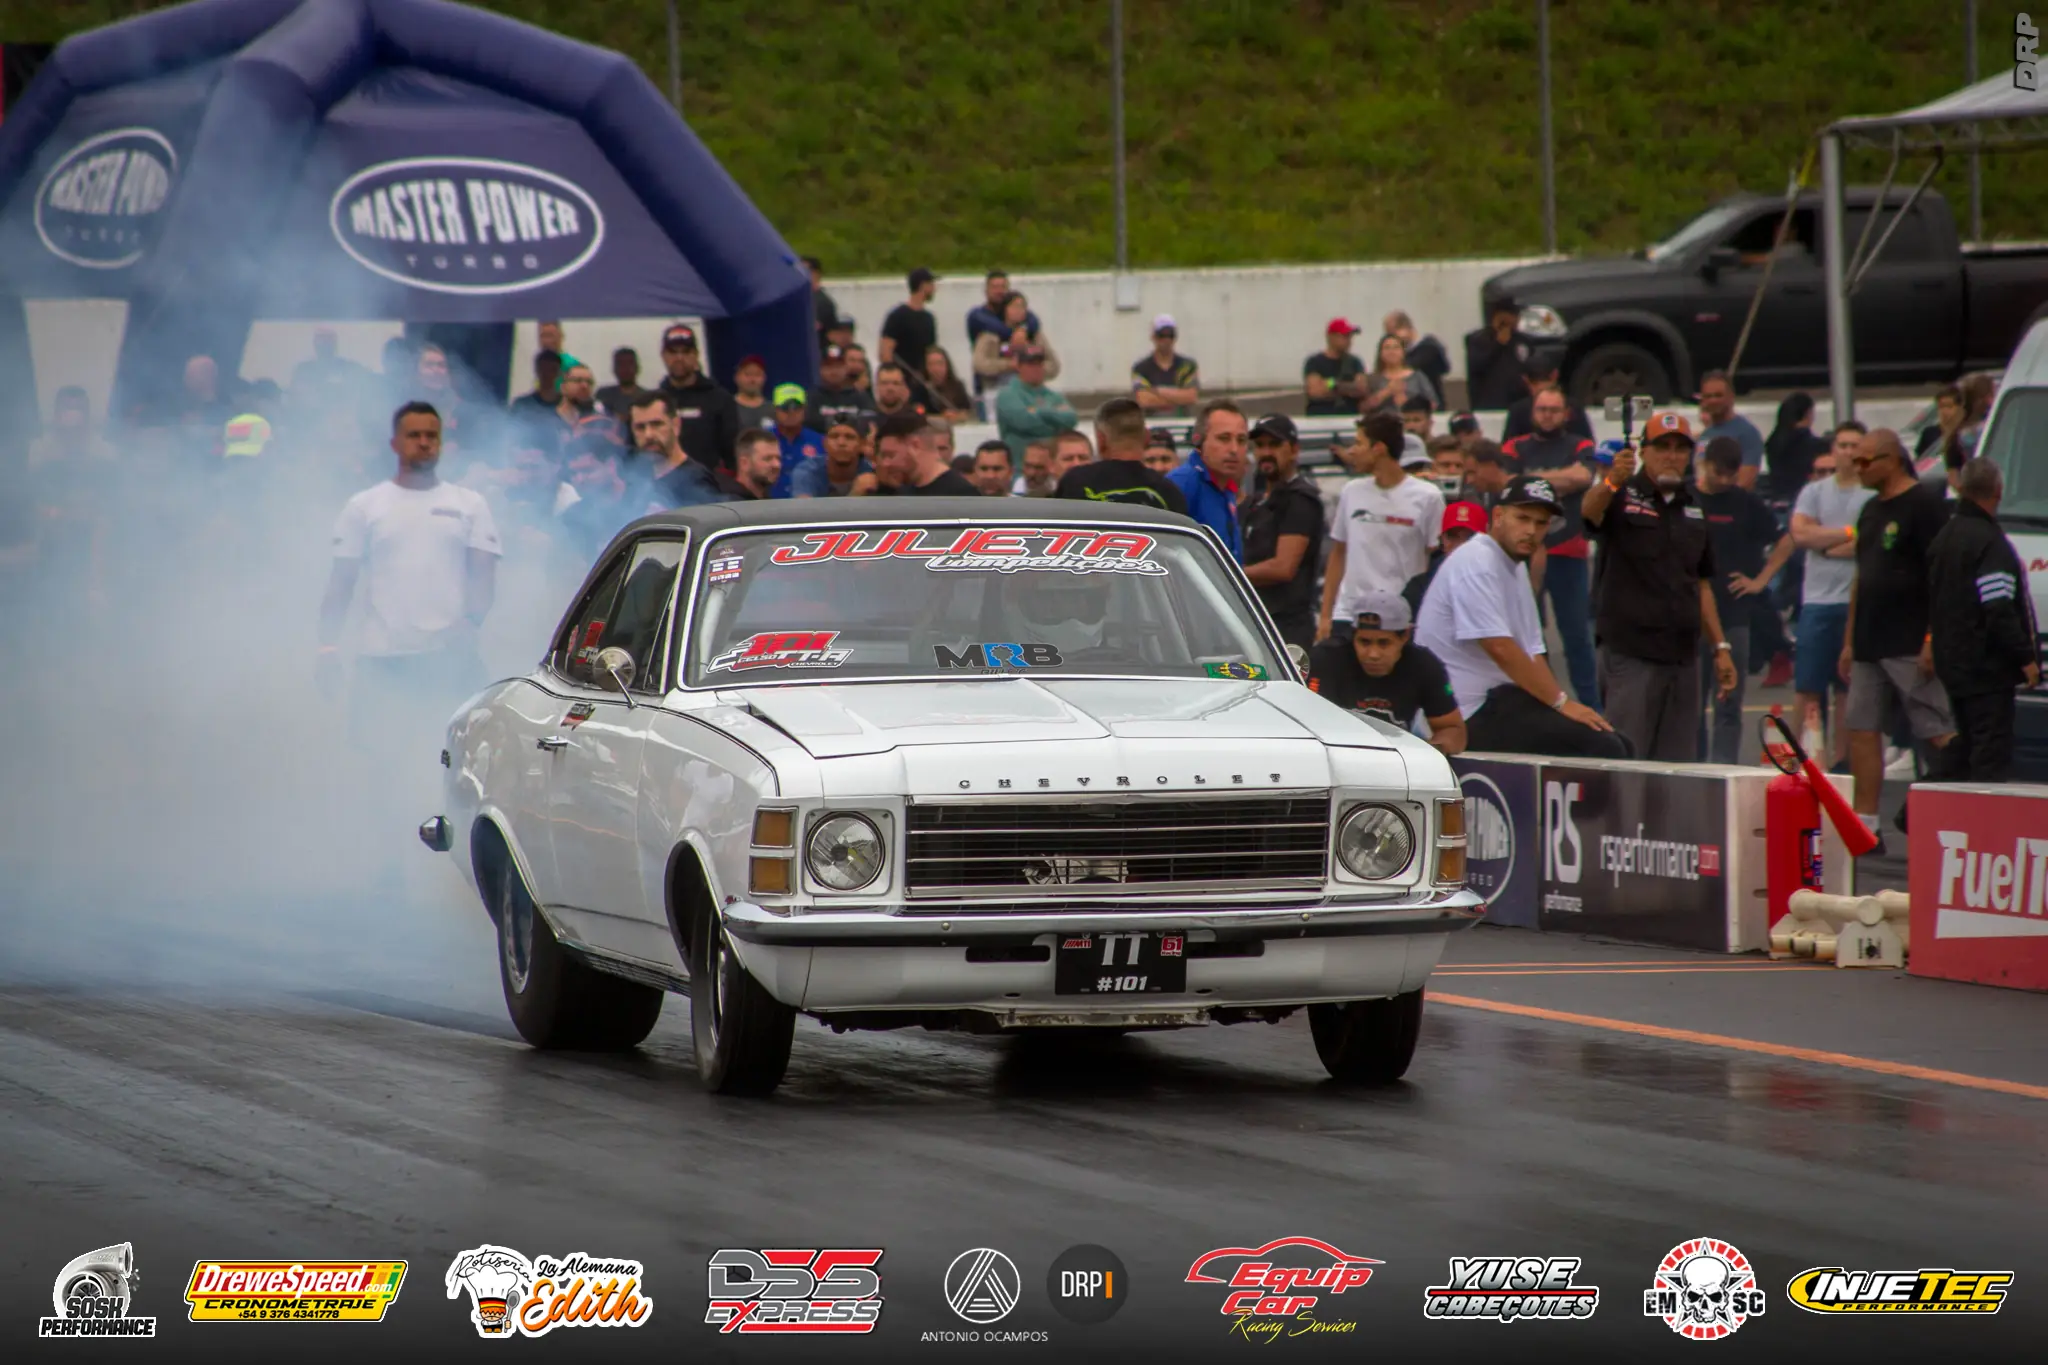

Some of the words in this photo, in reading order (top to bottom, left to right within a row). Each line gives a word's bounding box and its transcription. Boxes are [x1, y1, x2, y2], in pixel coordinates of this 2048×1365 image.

[351, 179, 467, 244] MASTER
[465, 179, 580, 244] POWER
[406, 254, 540, 270] TURBO
[770, 528, 1157, 564] JULIETA
[933, 643, 1063, 668] MRB
[958, 773, 1281, 789] CHEVROLET
[1937, 830, 2048, 916] FuelT
[1099, 934, 1149, 966] TT
[1097, 976, 1148, 992] #101
